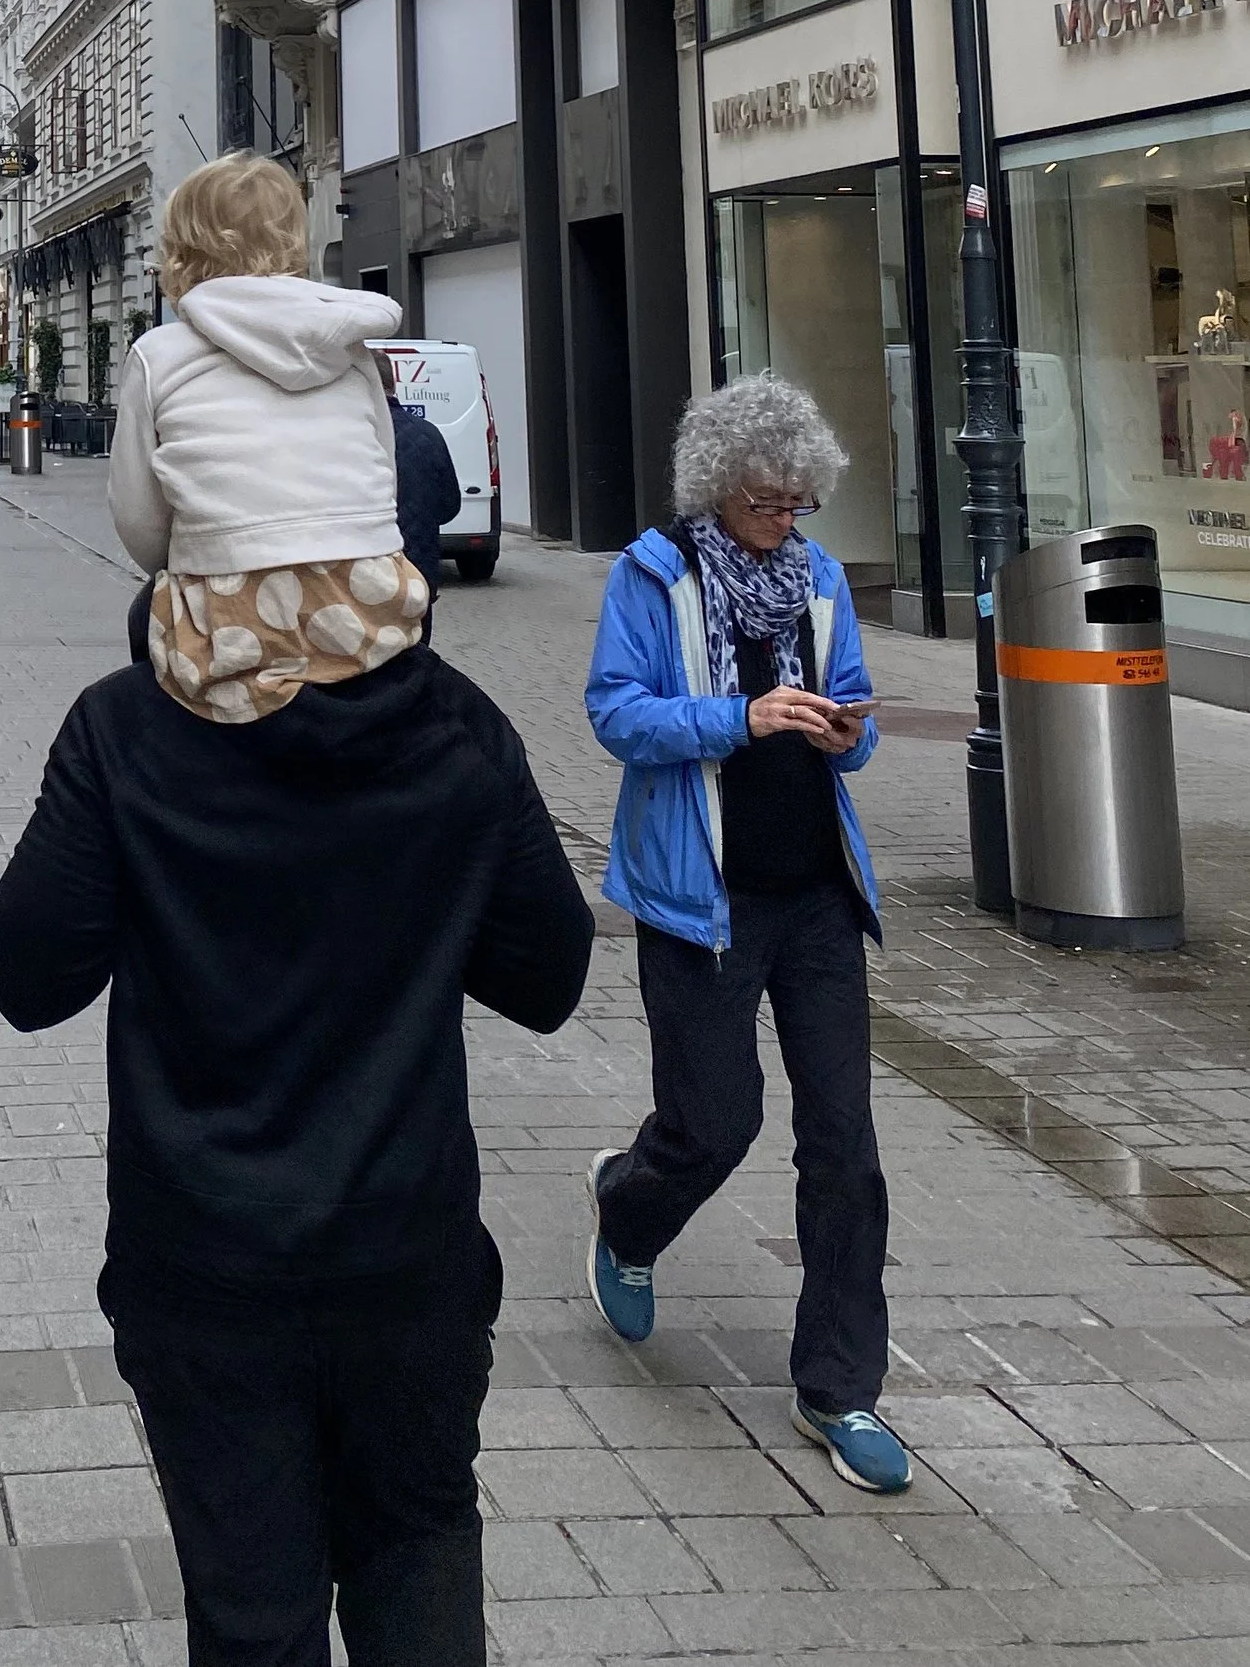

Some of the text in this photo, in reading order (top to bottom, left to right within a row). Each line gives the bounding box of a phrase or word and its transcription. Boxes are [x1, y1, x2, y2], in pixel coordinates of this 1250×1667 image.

[712, 57, 879, 134] MICHAEL KORS
[403, 385, 451, 403] Lüftung
[1197, 531, 1250, 549] CELEBRAT
